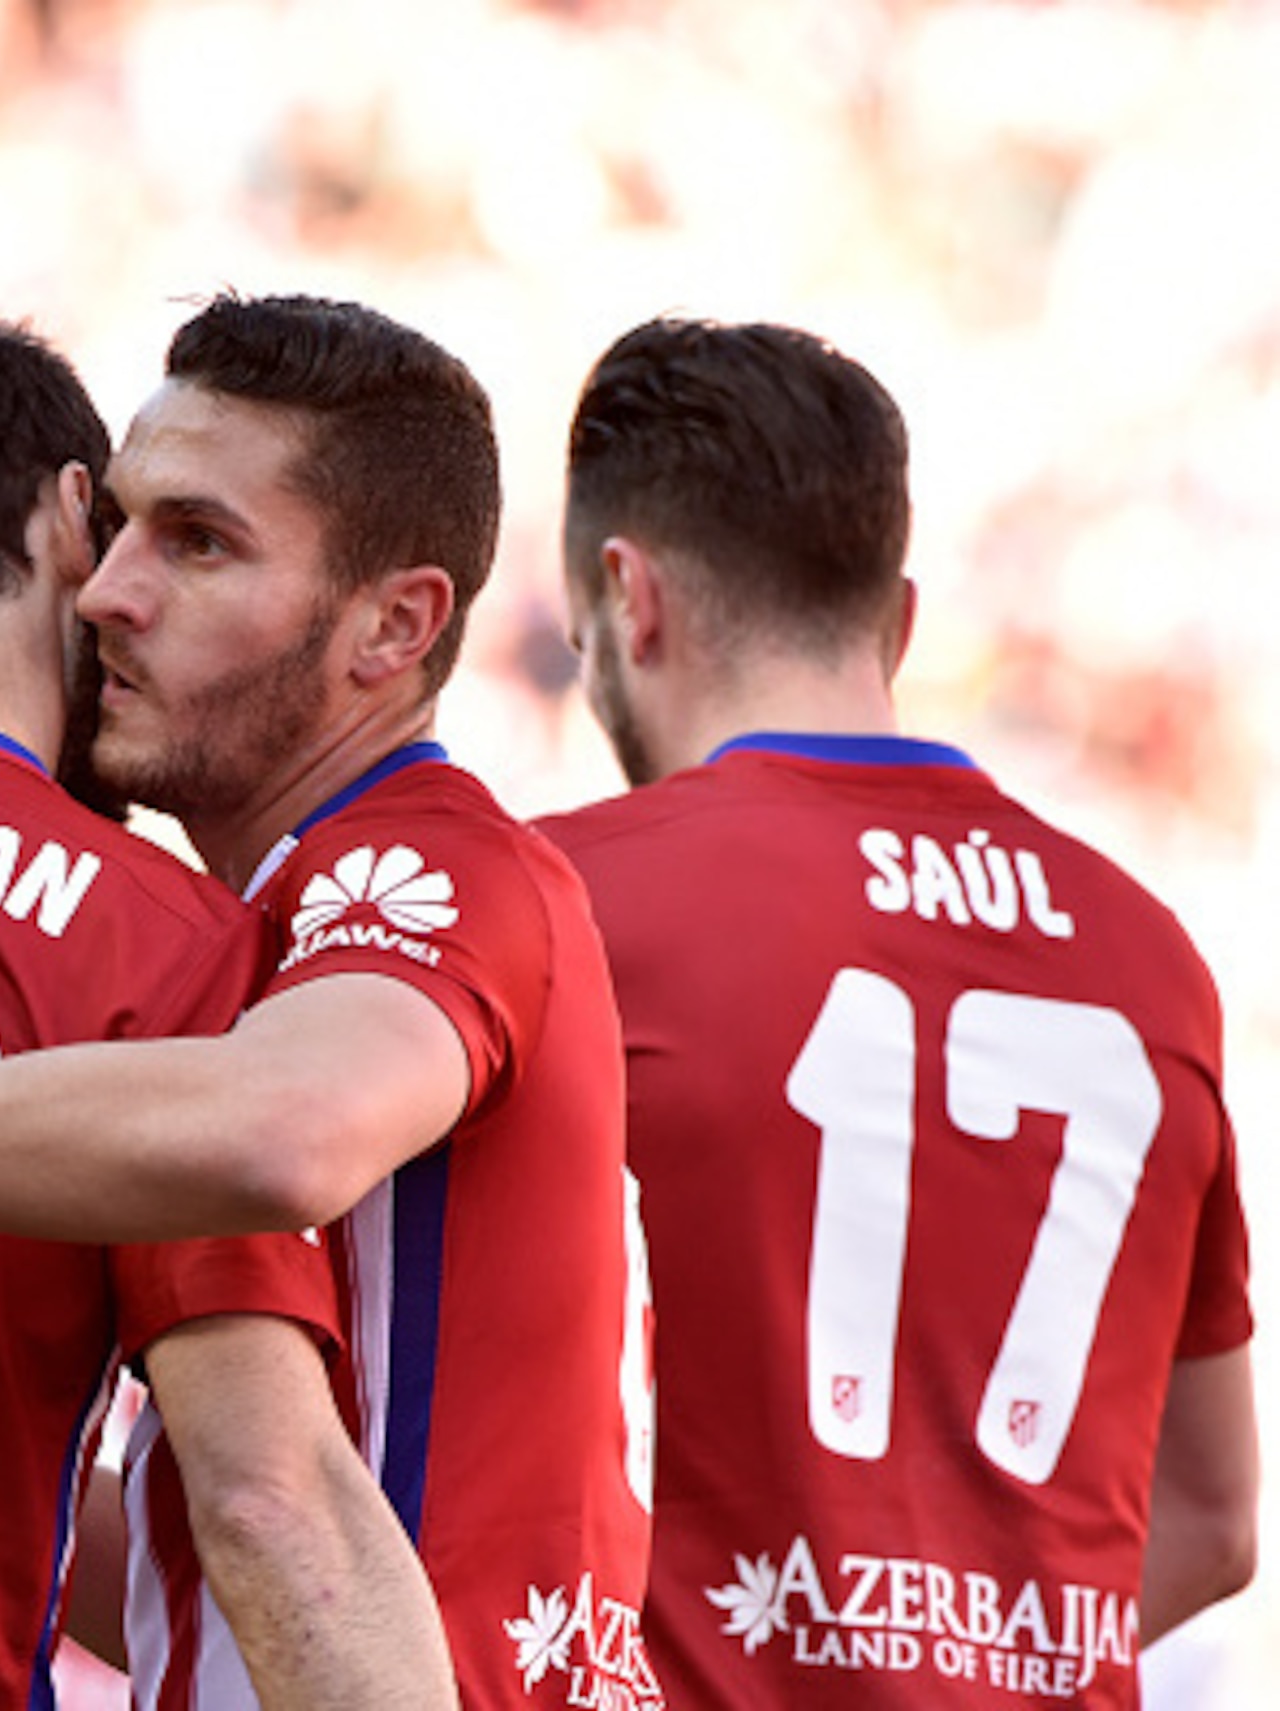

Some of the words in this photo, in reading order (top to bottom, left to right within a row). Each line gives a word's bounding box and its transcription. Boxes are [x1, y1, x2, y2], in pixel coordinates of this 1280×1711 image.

[858, 828, 1075, 939] SAÚL
[786, 966, 1163, 1486] 17
[792, 1625, 922, 1672] LAND
[933, 1636, 977, 1681] OF
[986, 1648, 1077, 1699] FIRE
